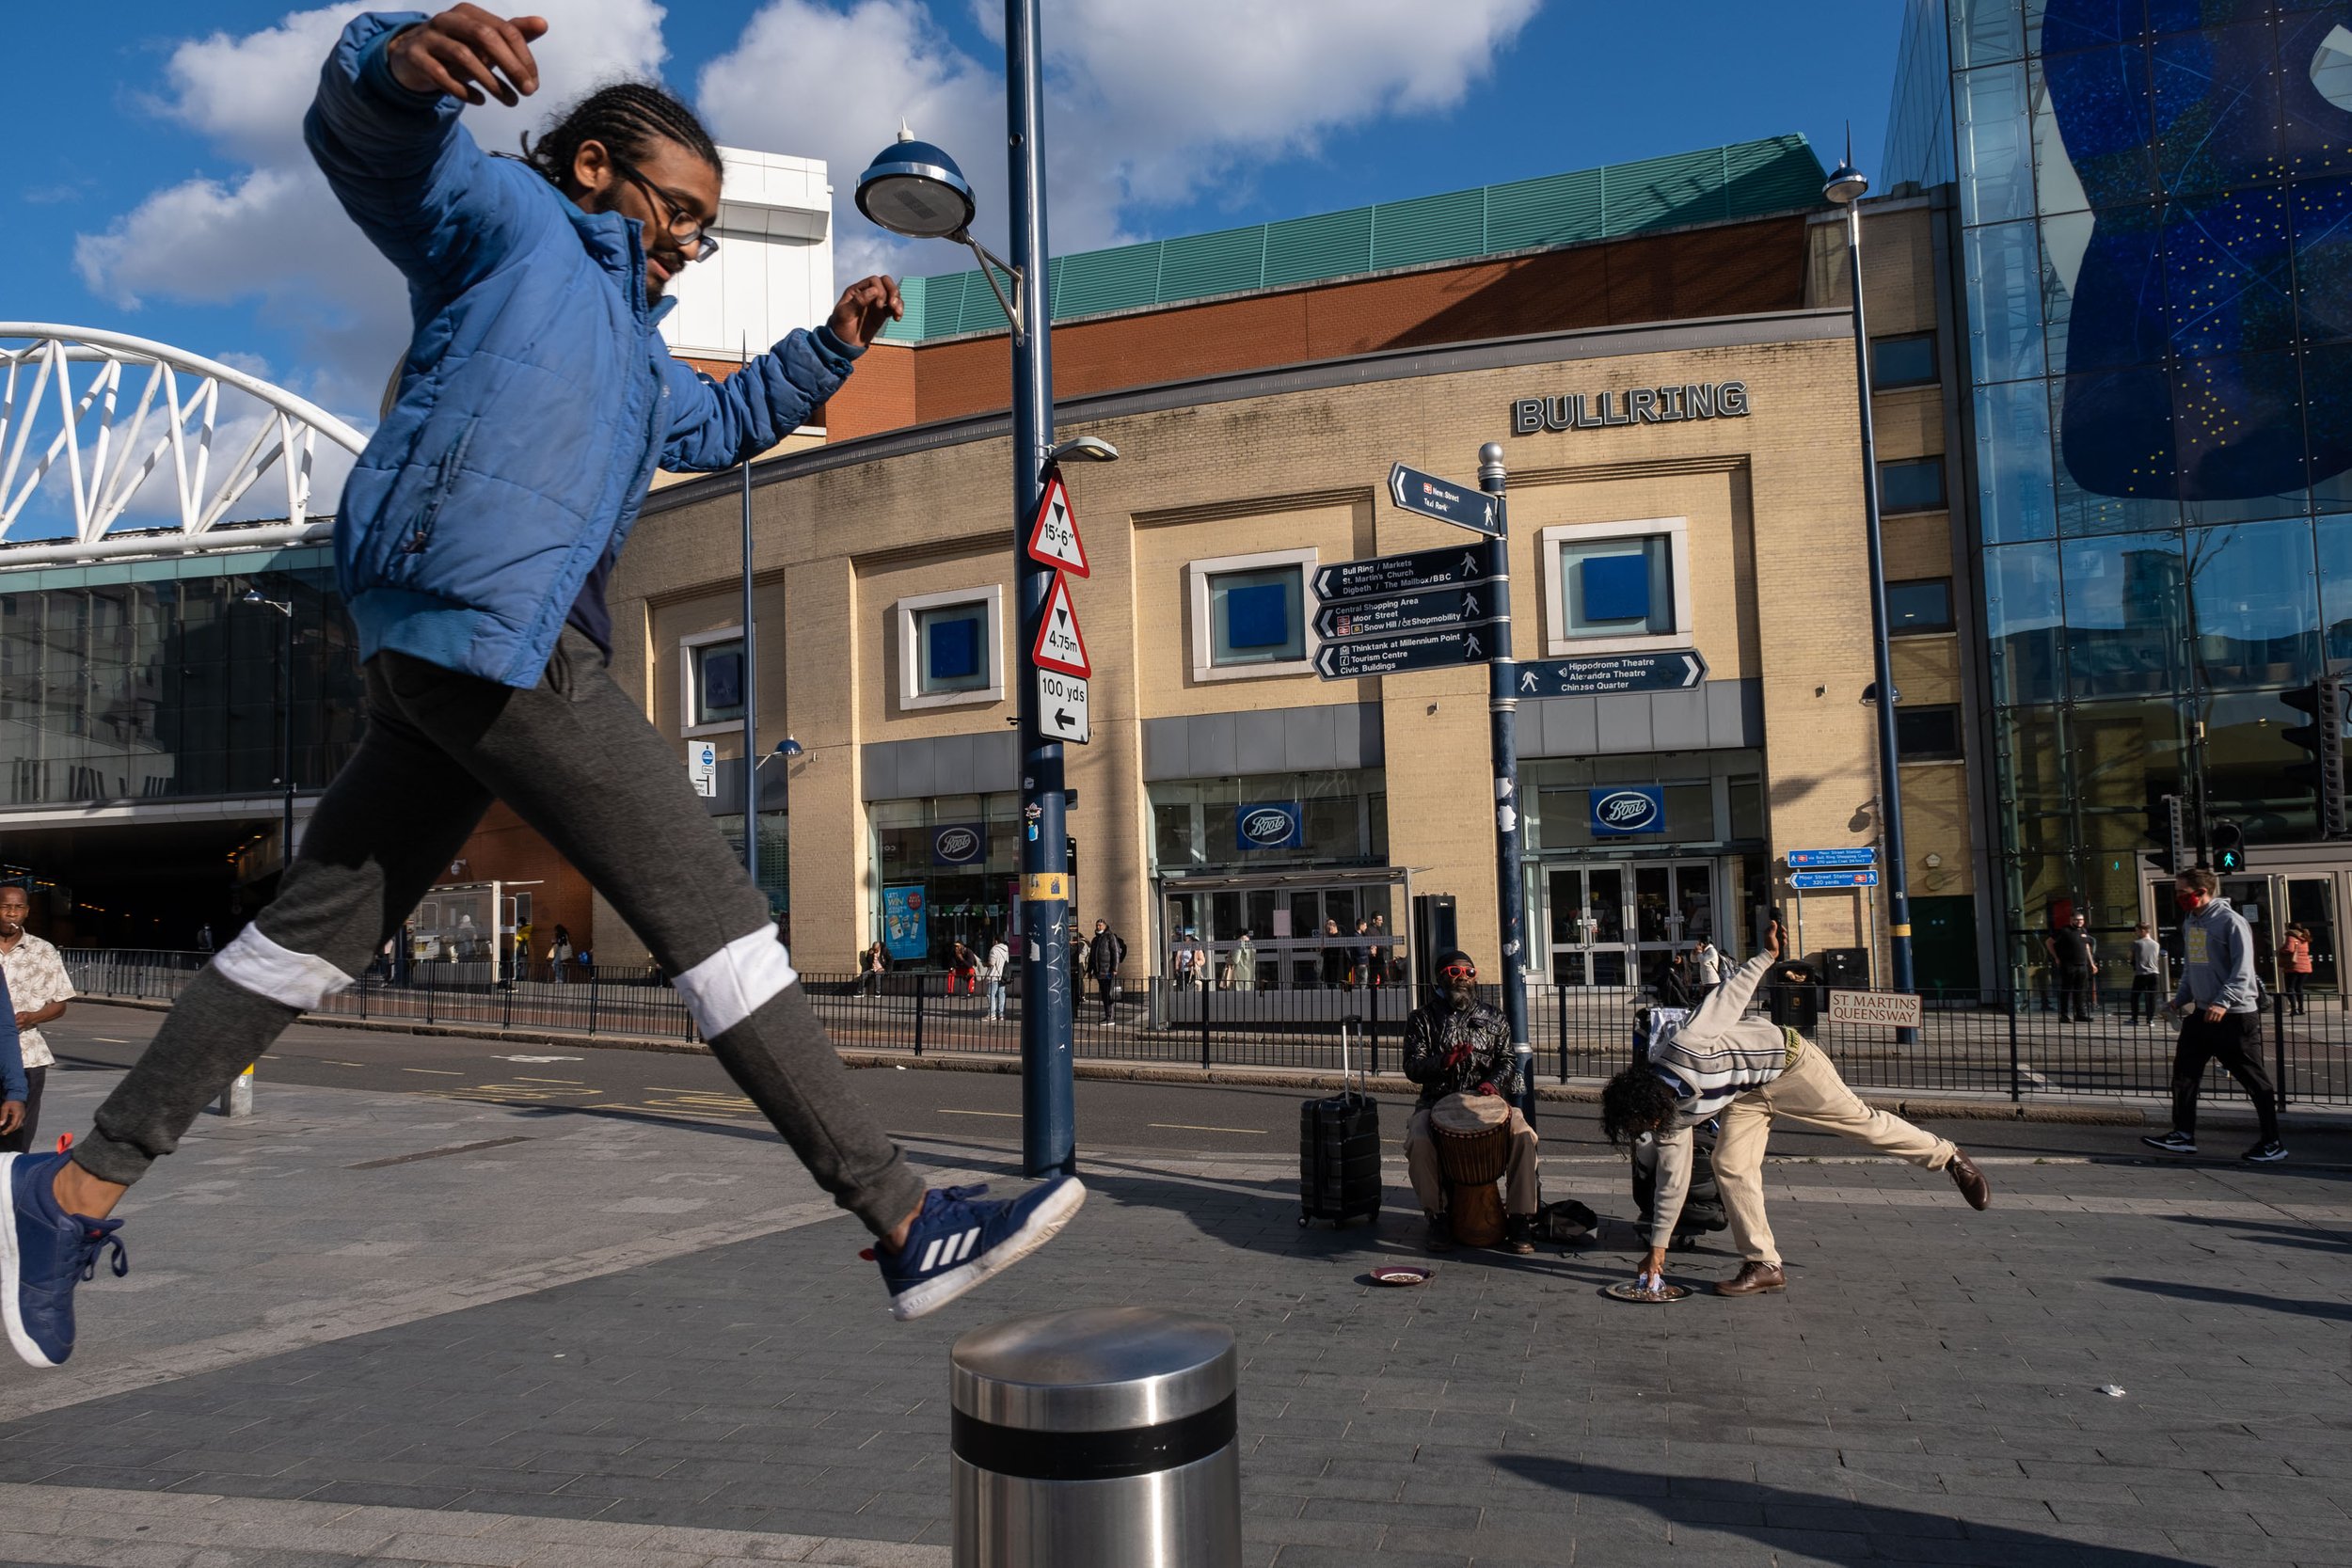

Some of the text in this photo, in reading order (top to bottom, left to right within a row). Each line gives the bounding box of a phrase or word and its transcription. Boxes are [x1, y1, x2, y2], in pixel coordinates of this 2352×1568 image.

[1516, 380, 1750, 434] BULLRING
[1433, 487, 1459, 502] New Street
[1423, 498, 1448, 512] Taxi Rank
[1044, 523, 1073, 546] 15'-6"
[1343, 567, 1357, 576] Bull
[1358, 565, 1374, 574] Ring
[1383, 560, 1412, 570] Markets
[1355, 573, 1384, 583] Martin's
[1387, 569, 1414, 578] Church
[1343, 585, 1372, 594] Digbeth
[1385, 580, 1398, 589] The
[1336, 605, 1361, 614] Central
[1364, 601, 1399, 611] Shopping
[1353, 610, 1398, 623] Moor Street
[1364, 623, 1384, 631] Snow
[1411, 613, 1461, 626] Shopmobility
[1049, 630, 1077, 653] 4.75m
[1351, 642, 1389, 653] Thinktank
[1400, 636, 1438, 647] Millennium
[1440, 634, 1461, 642] Point
[1351, 651, 1408, 663] Tourism Centre
[1340, 662, 1396, 674] Civic Buildings
[1569, 658, 1655, 672] Hippodrome Theatre
[1613, 670, 1646, 678] Theatre
[1042, 677, 1085, 703] 100 yds
[1597, 681, 1629, 690] Quarter
[1605, 800, 1647, 821] Boots
[1248, 816, 1285, 836] Boots
[942, 833, 971, 853] Boots
[1853, 995, 1916, 1010] MARTINS
[1834, 1007, 1915, 1023] QUEENSWAY
